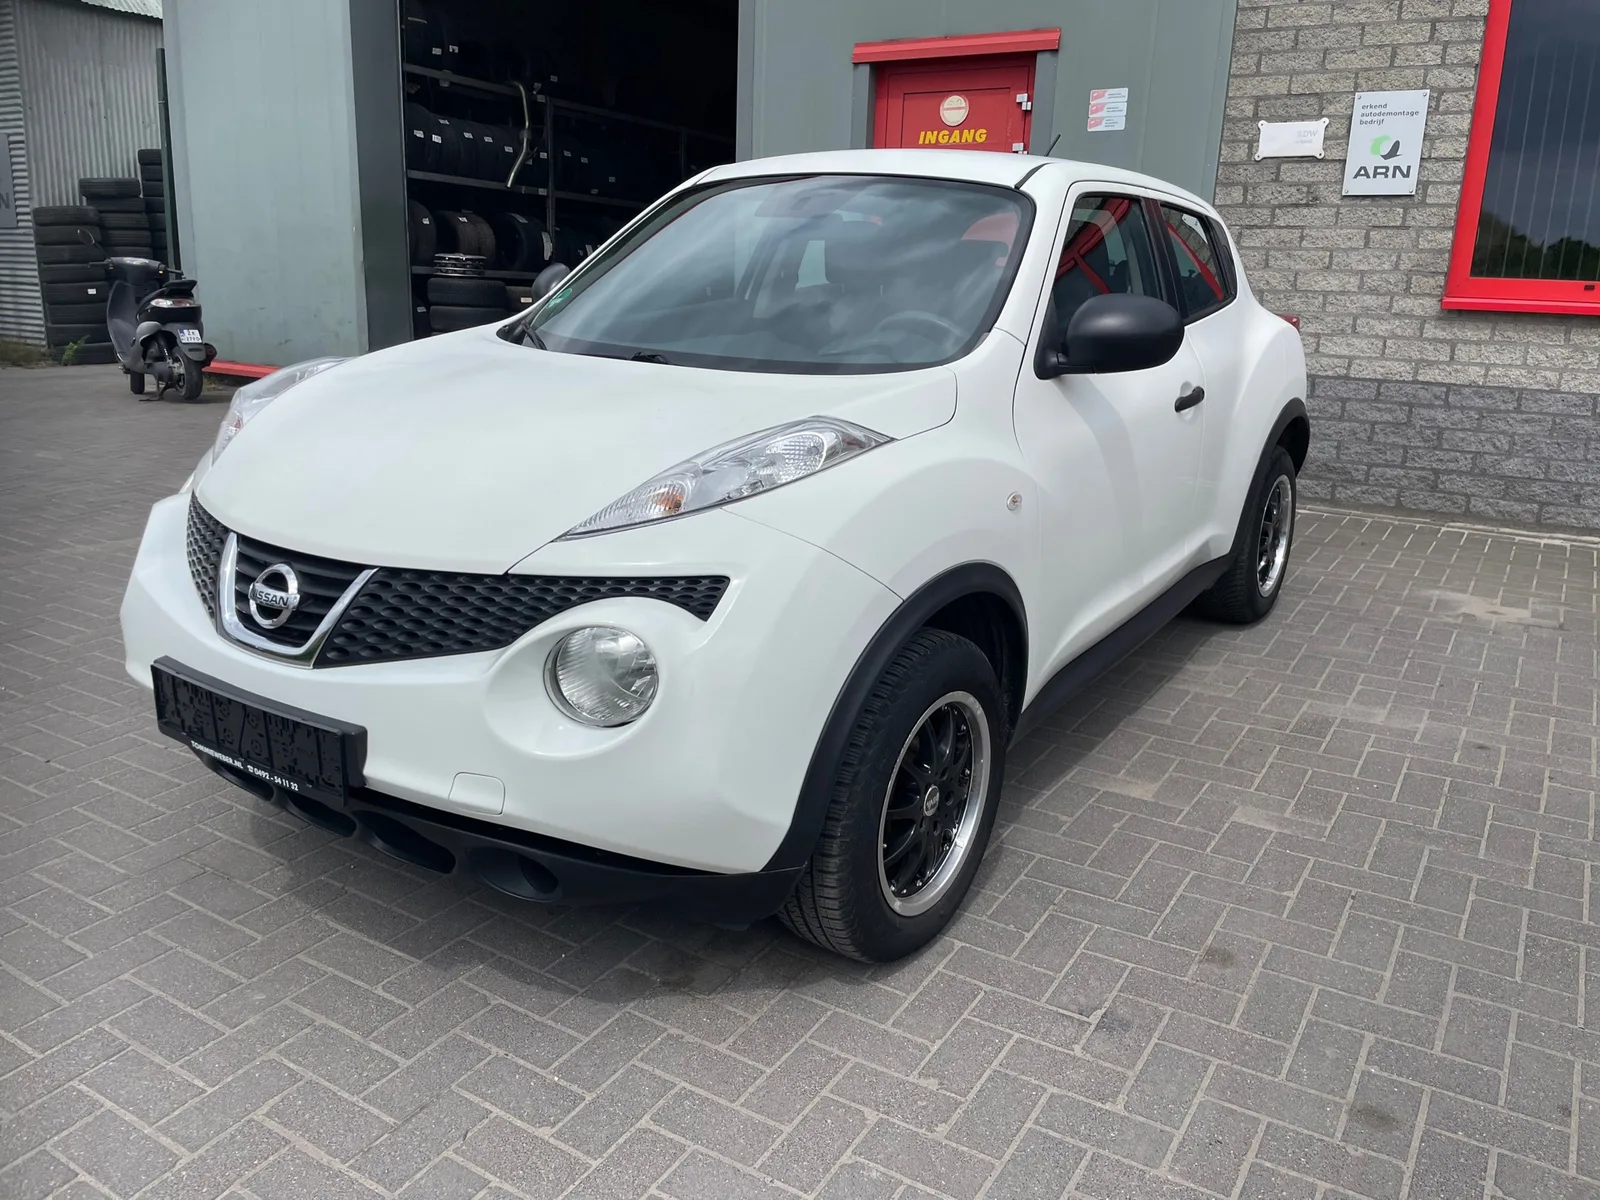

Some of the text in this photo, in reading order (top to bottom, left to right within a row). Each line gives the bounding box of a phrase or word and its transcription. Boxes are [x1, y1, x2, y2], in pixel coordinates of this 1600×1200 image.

[1360, 110, 1420, 118] autodemontage
[918, 128, 987, 144] INGANG
[1352, 165, 1412, 179] ARN
[251, 587, 289, 606] NISSAN
[254, 767, 270, 780] 0492
[274, 775, 282, 785] 54
[282, 778, 289, 788] 11
